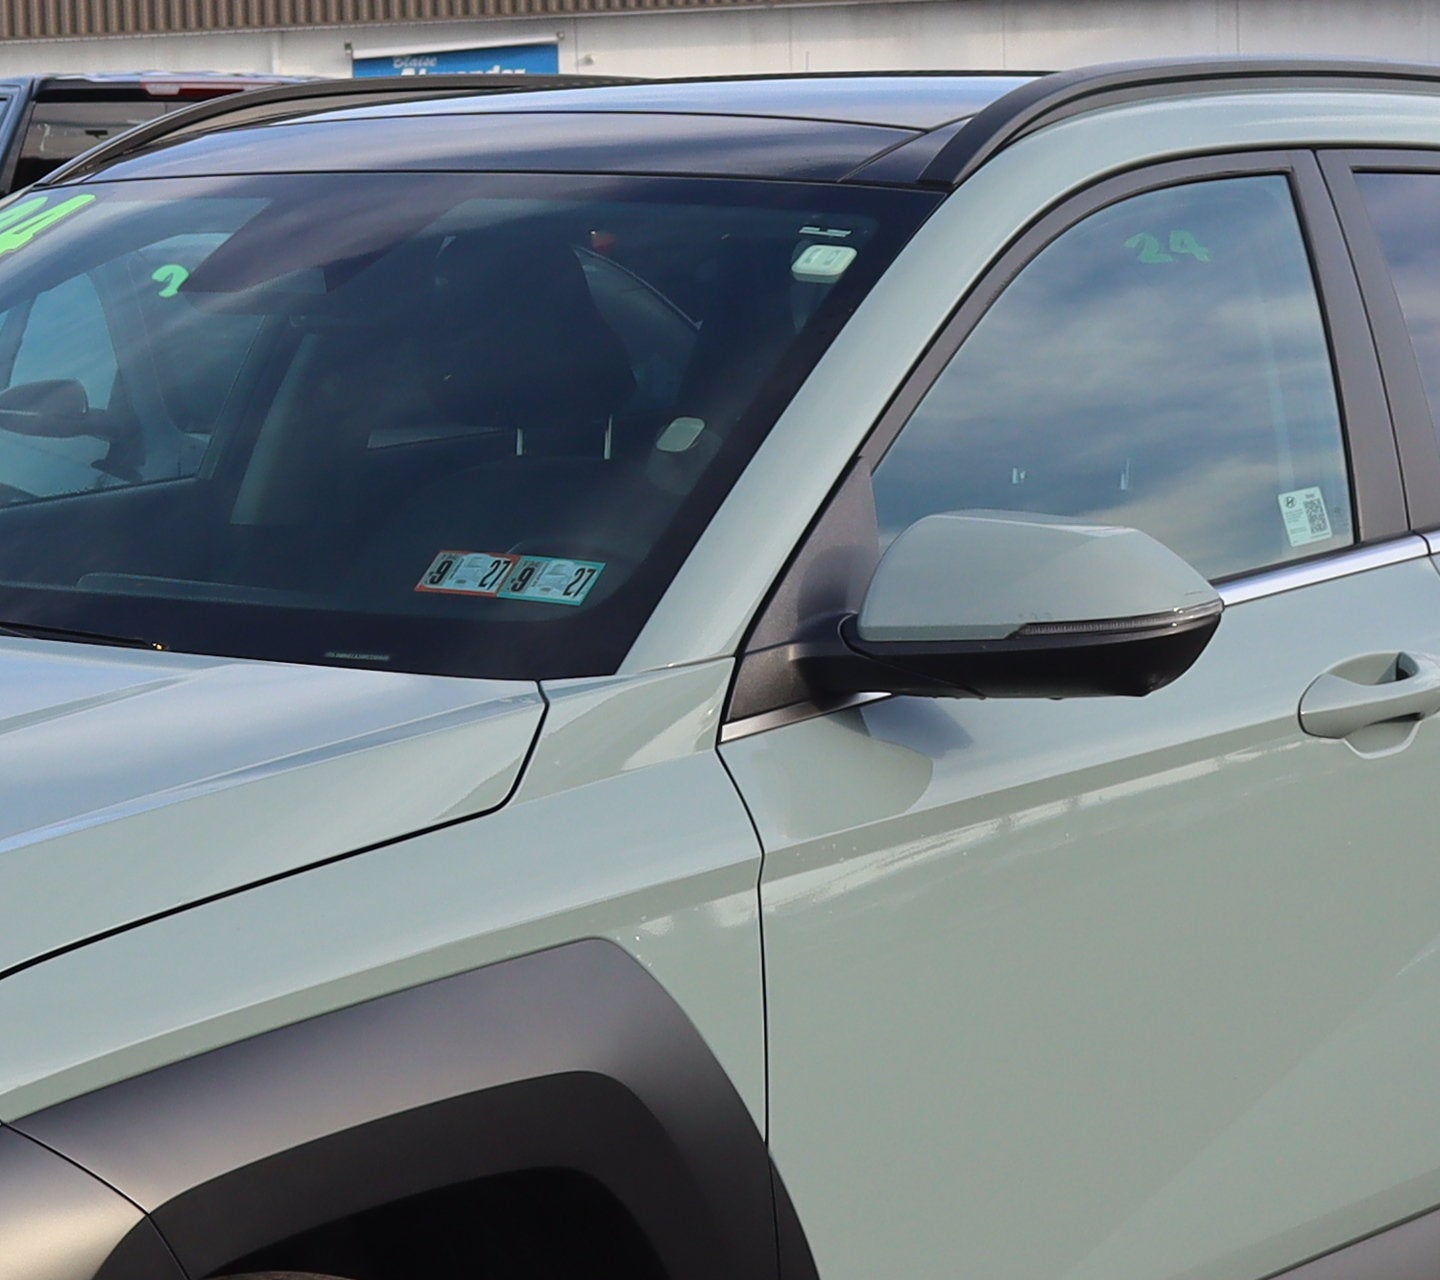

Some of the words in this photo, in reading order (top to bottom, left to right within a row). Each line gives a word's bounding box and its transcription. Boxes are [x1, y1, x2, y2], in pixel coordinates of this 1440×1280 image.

[1123, 229, 1212, 264] 24
[478, 559, 512, 591] 27
[562, 567, 597, 598] 27
